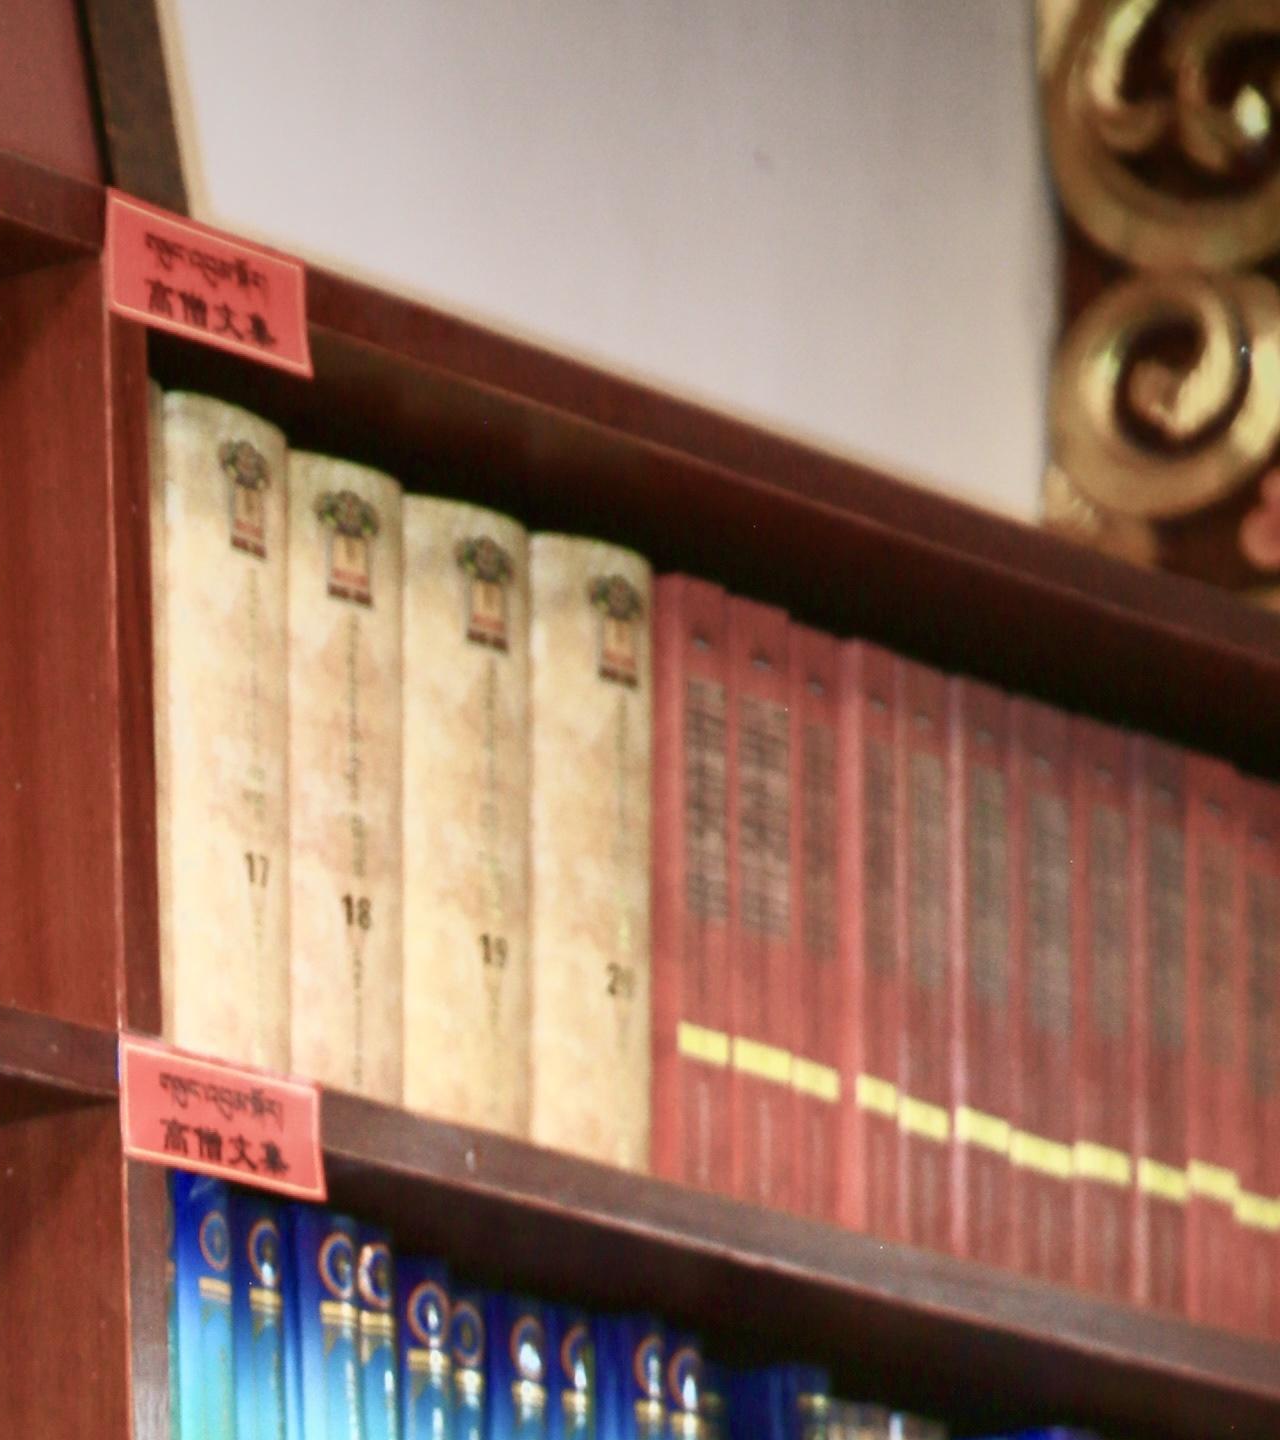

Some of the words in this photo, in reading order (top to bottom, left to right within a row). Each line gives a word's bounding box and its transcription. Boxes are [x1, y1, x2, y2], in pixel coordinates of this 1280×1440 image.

[244, 852, 271, 889] 17
[341, 894, 372, 932] 18
[479, 934, 508, 972] 19
[159, 1117, 292, 1175] 高僧文集
